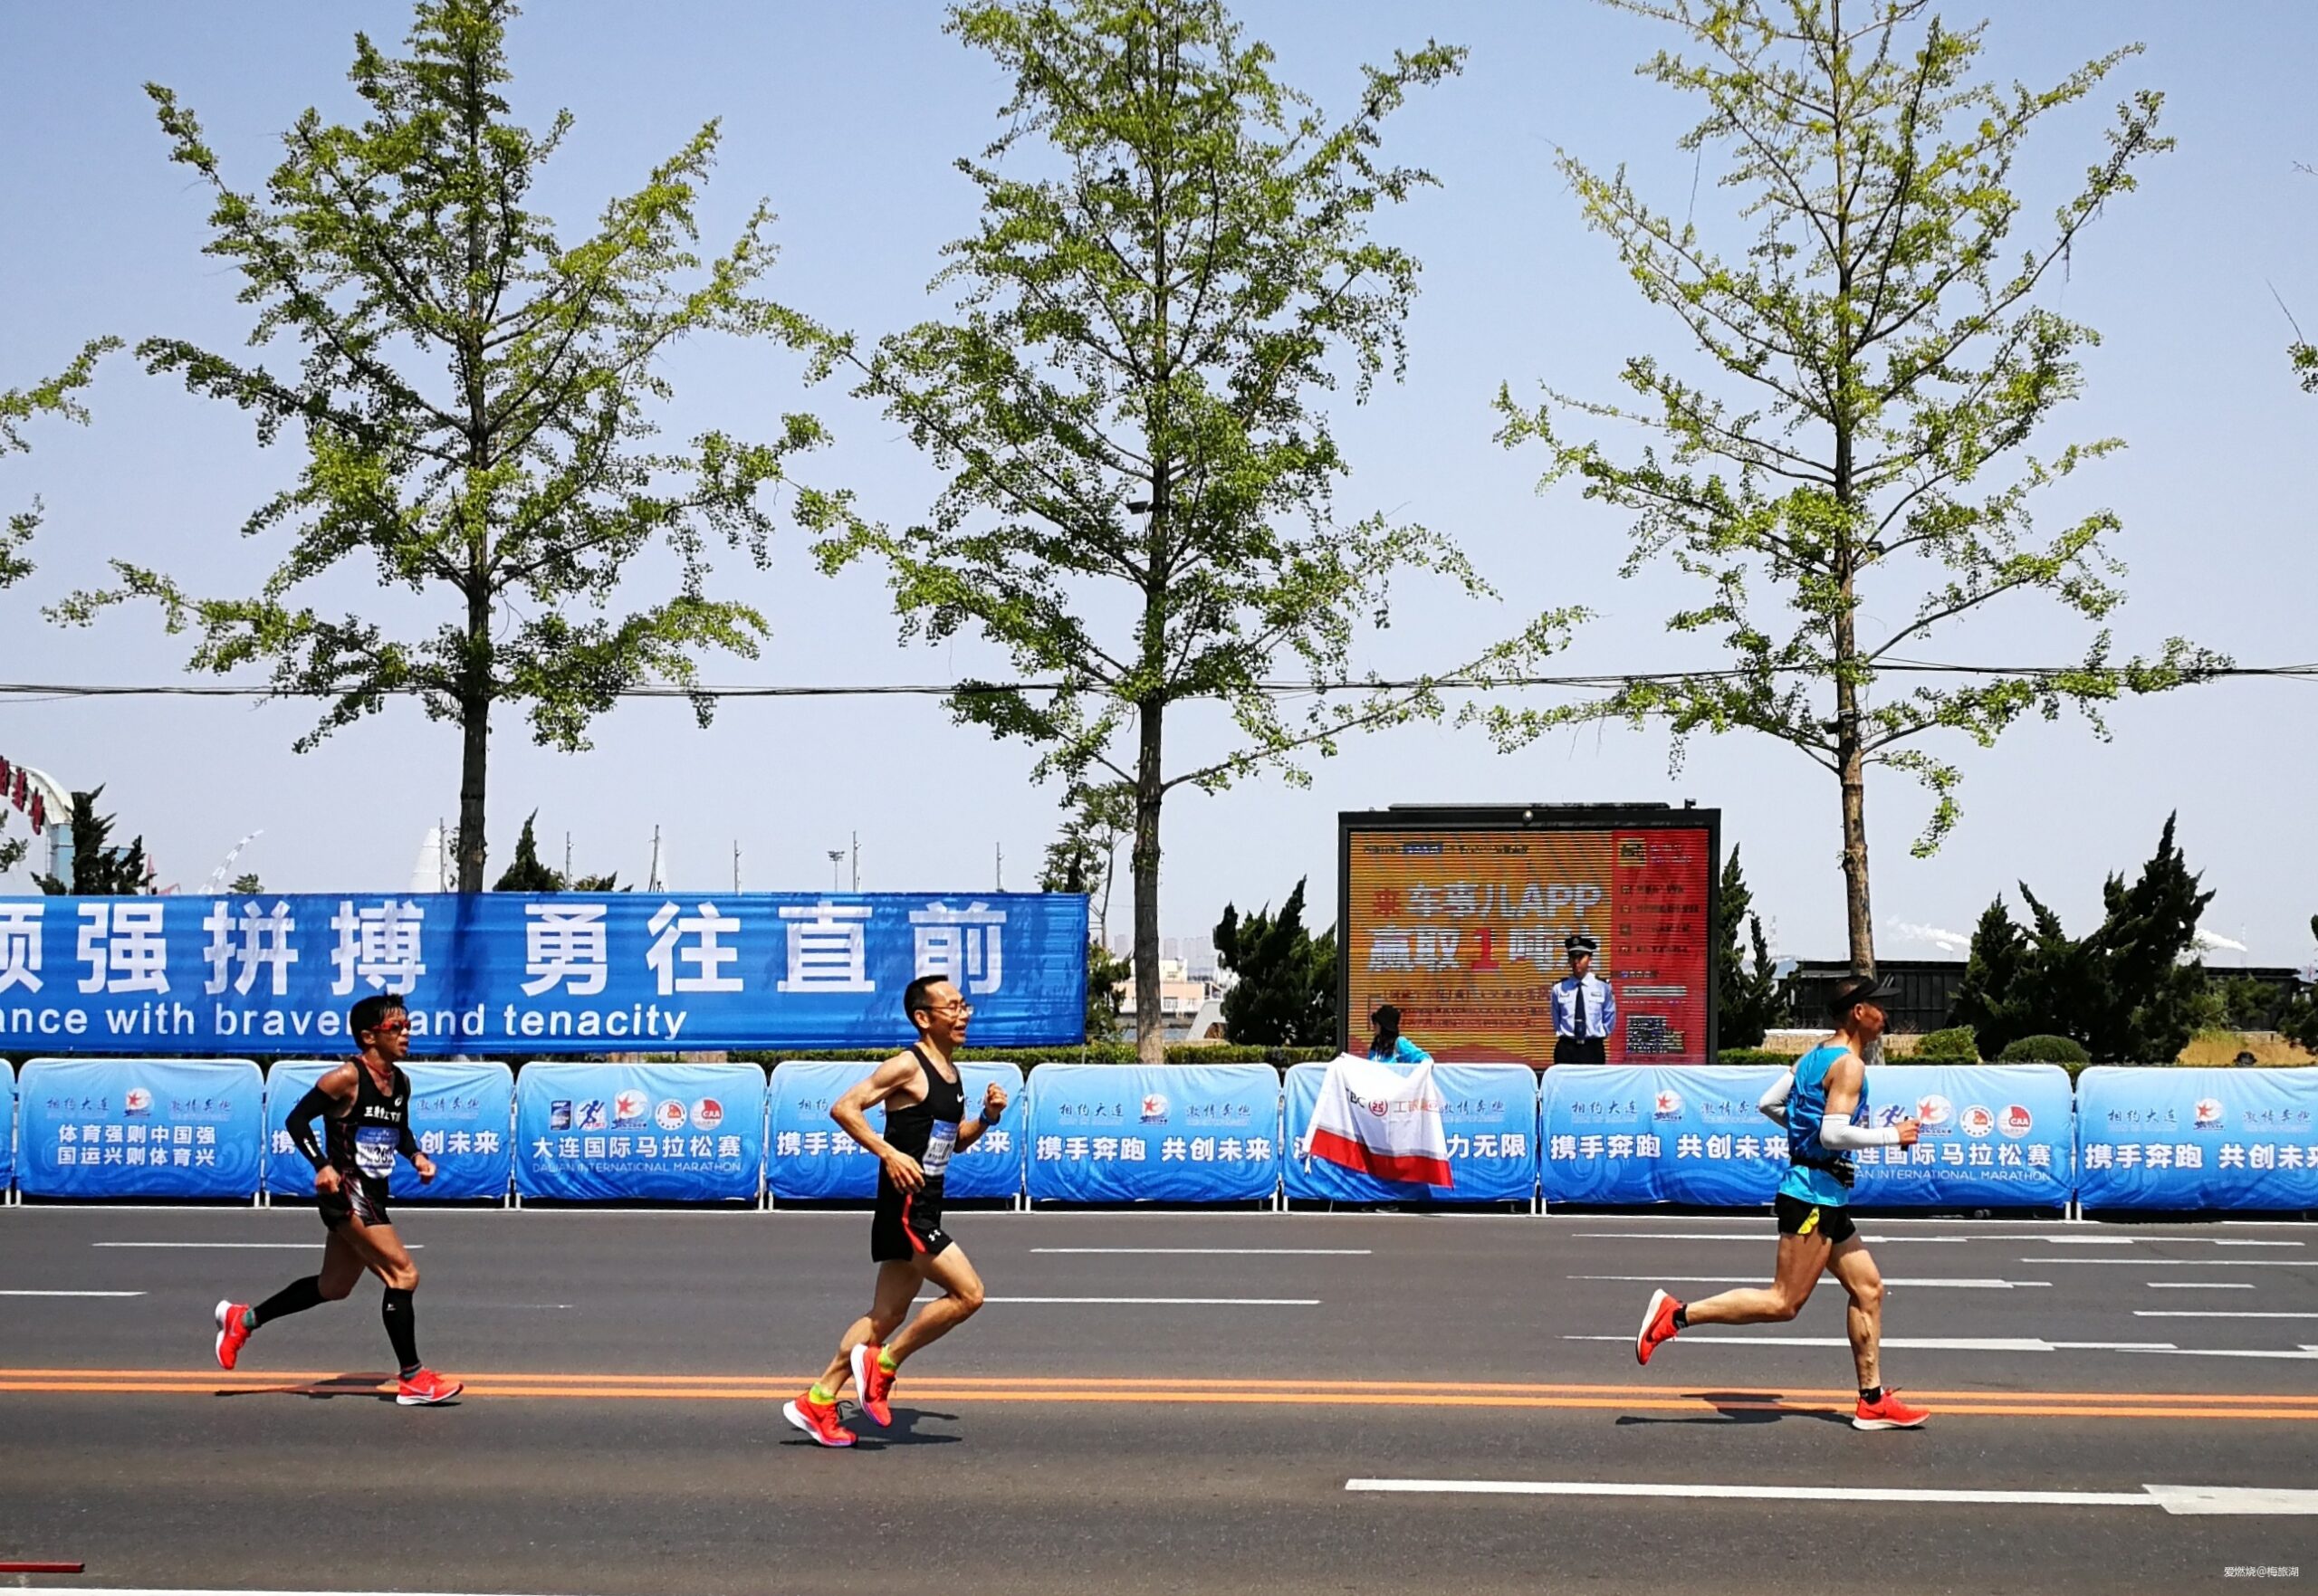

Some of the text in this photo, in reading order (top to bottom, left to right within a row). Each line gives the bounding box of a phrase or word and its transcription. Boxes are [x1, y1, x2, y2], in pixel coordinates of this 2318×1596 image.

[520, 900, 1007, 996] 勇往直前
[0, 1001, 688, 1042] nce with brave and tenacity
[59, 1124, 216, 1145] 体育强则中国强
[413, 1130, 500, 1155] 创未来
[532, 1134, 742, 1160] 大连国际马拉松赛
[1447, 1134, 1527, 1159] 力无限
[1550, 1133, 1790, 1161] 携手奔跑 共创未来
[57, 1146, 216, 1167] 国运兴则体育兴
[1037, 1135, 1146, 1161] 携手奔跑
[1161, 1136, 1271, 1162] 共创未来
[1856, 1142, 2051, 1168] 连国际马拉松赛
[2085, 1143, 2203, 1170] 携手奔跑
[532, 1161, 741, 1173] DALIAN INTERNATIONAL MARATHON
[1877, 1169, 1975, 1180] INTERNATIONAL
[1981, 1171, 2051, 1181] MARATHON
